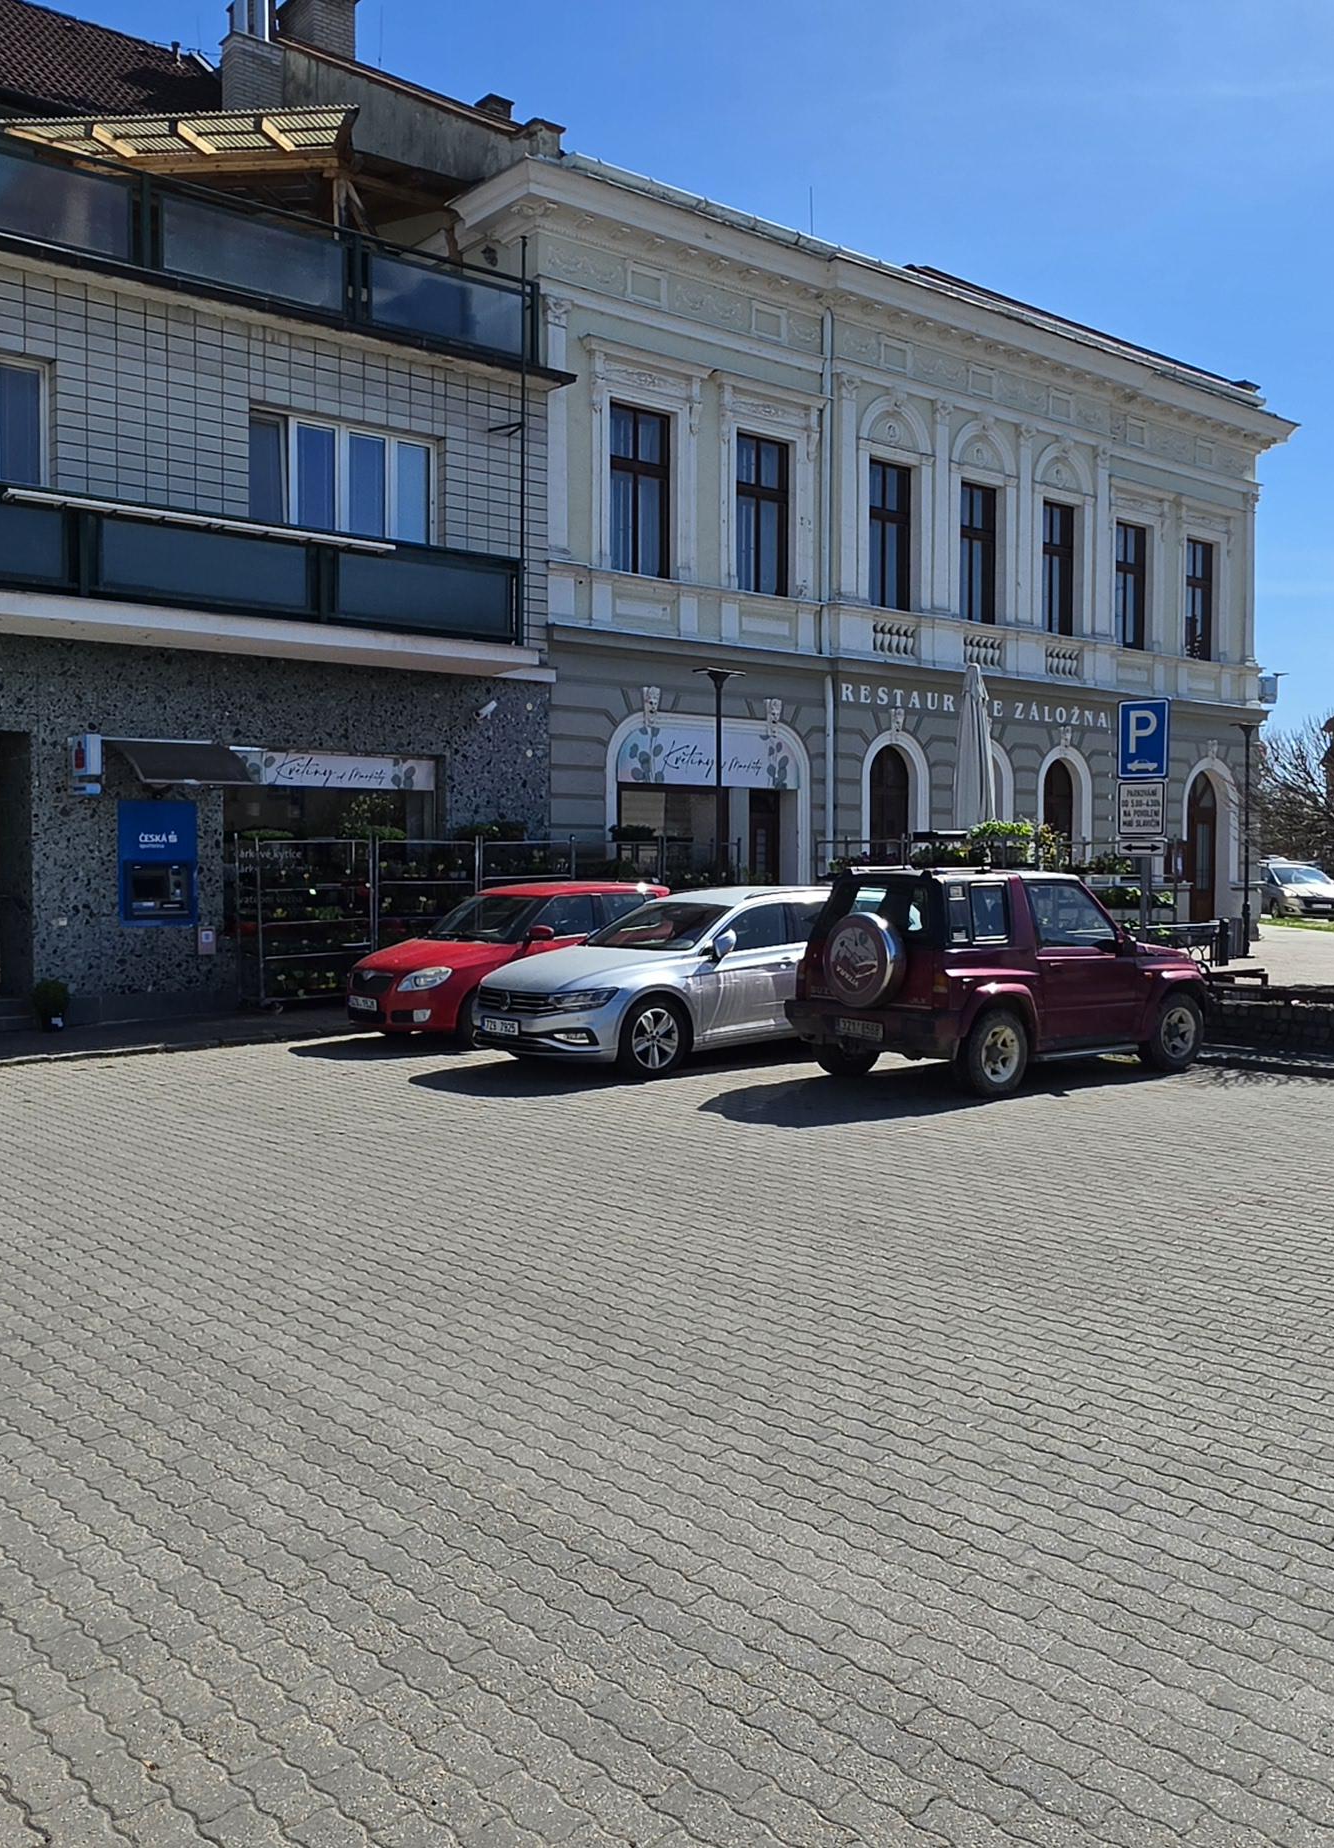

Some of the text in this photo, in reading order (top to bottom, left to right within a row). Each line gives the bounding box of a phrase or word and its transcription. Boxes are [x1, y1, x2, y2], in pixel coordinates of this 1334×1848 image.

[841, 682, 1108, 729] RESTAURE ZÁLOŽNA
[1129, 710, 1158, 754] P
[138, 832, 167, 843] ČESKÁ
